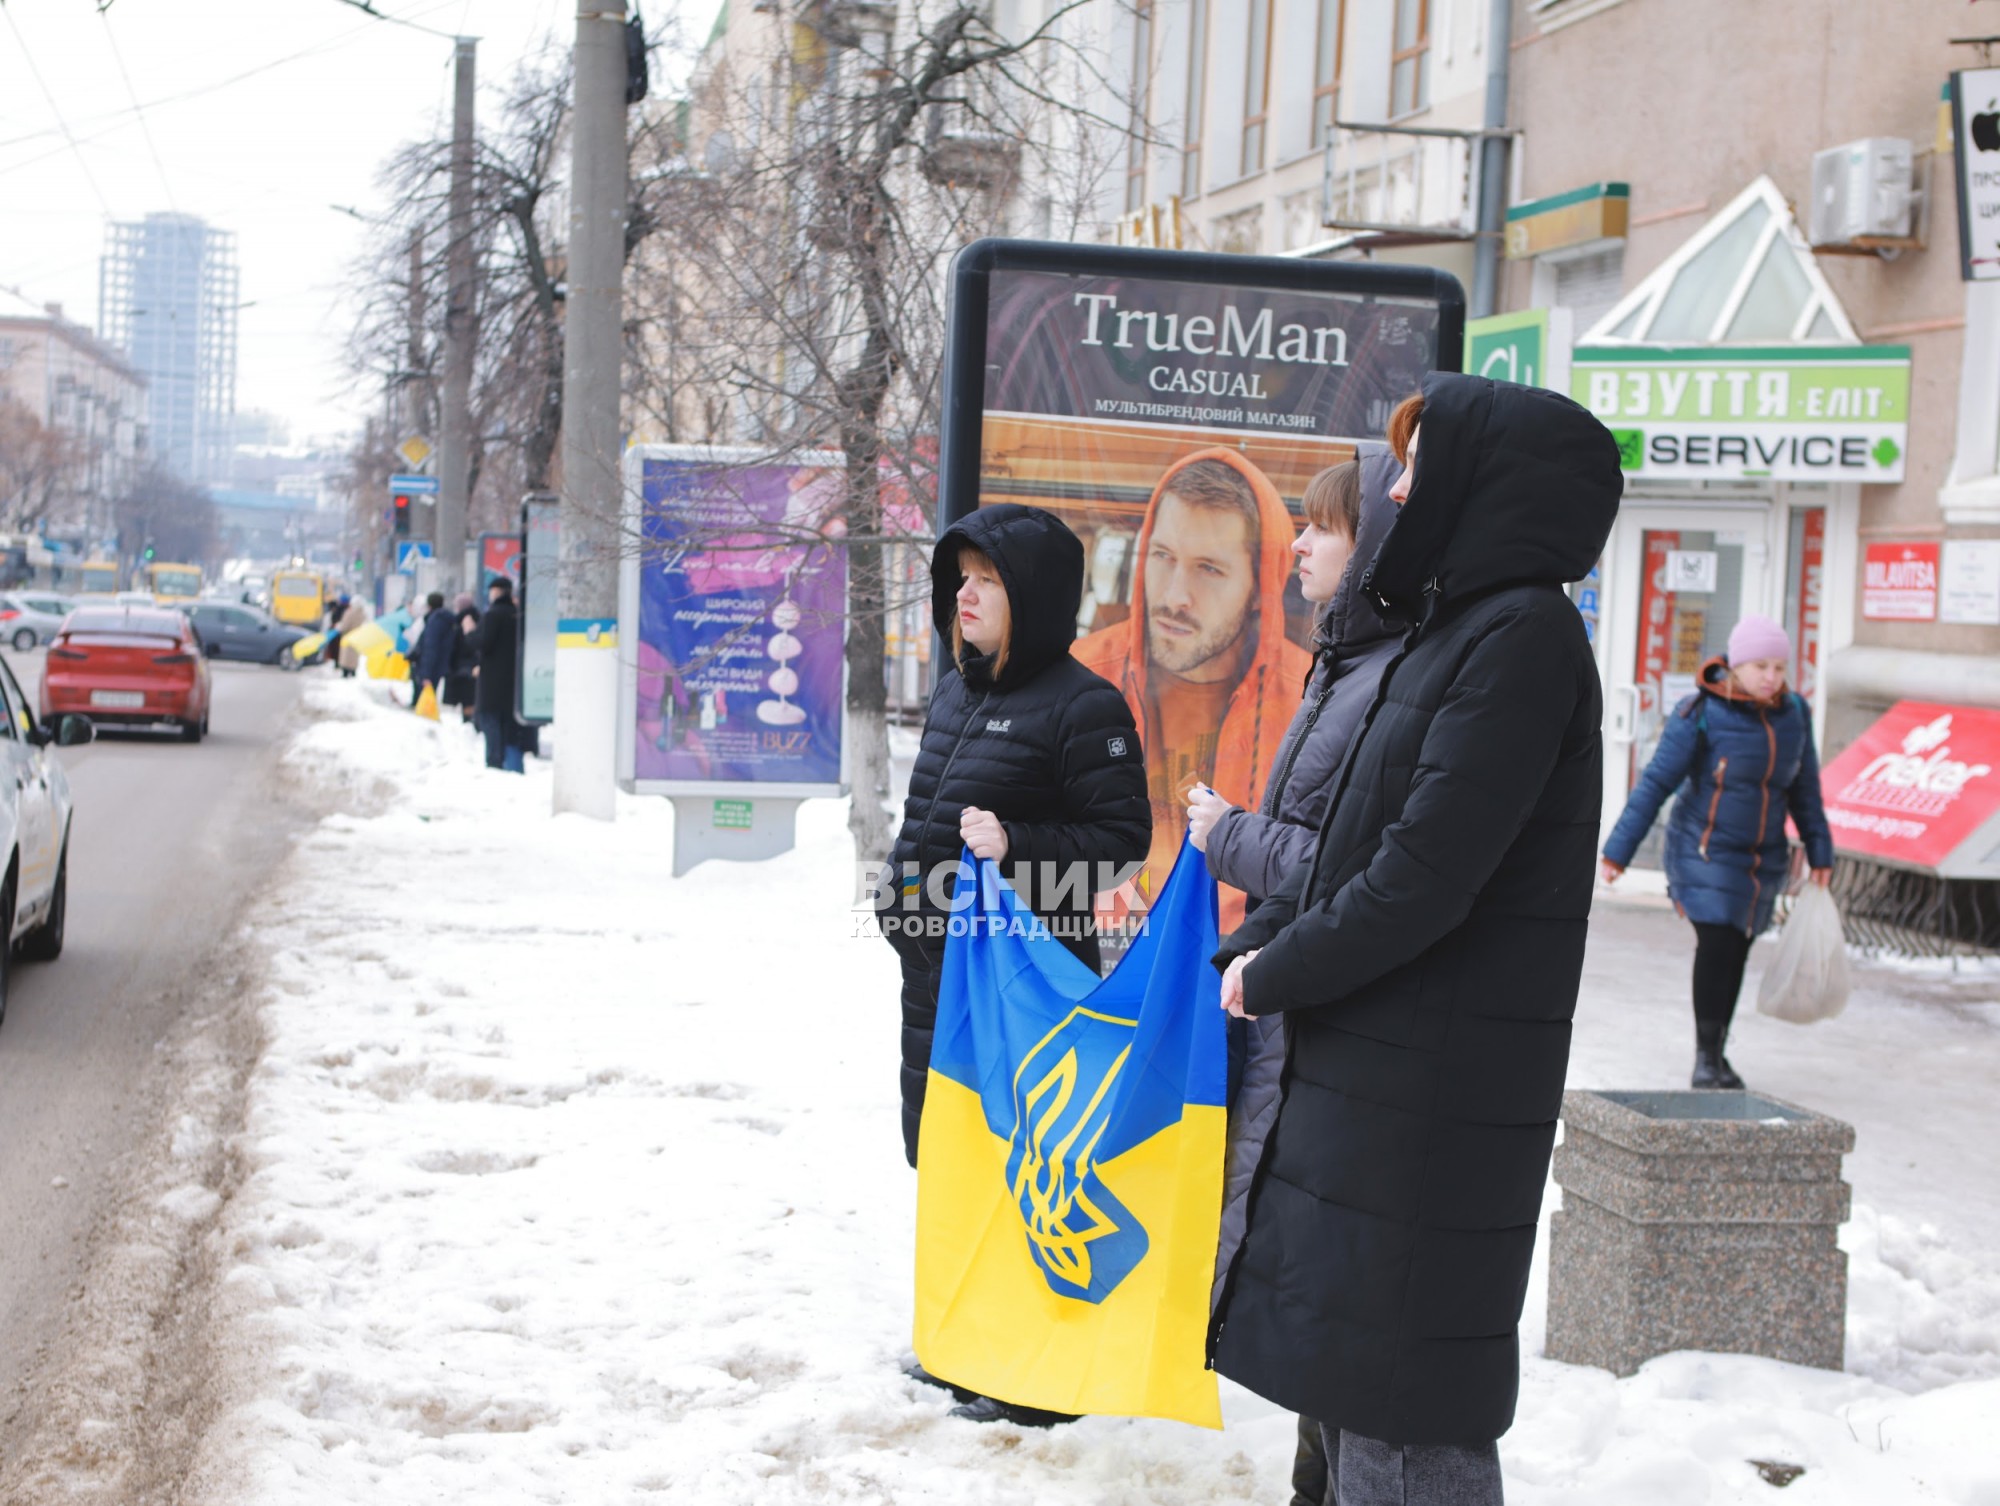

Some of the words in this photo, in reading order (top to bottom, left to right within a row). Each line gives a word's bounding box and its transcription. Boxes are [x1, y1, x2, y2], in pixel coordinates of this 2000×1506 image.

[1074, 292, 1349, 366] TrueMan
[1149, 366, 1267, 400] CASUAL
[1589, 371, 1789, 417] ВЗУТТЯ
[1095, 399, 1243, 424] МУЛЬТИБРЕНДОВИЙ
[1246, 411, 1316, 429] МАГАЗИН
[1650, 435, 1868, 467] SERVICE
